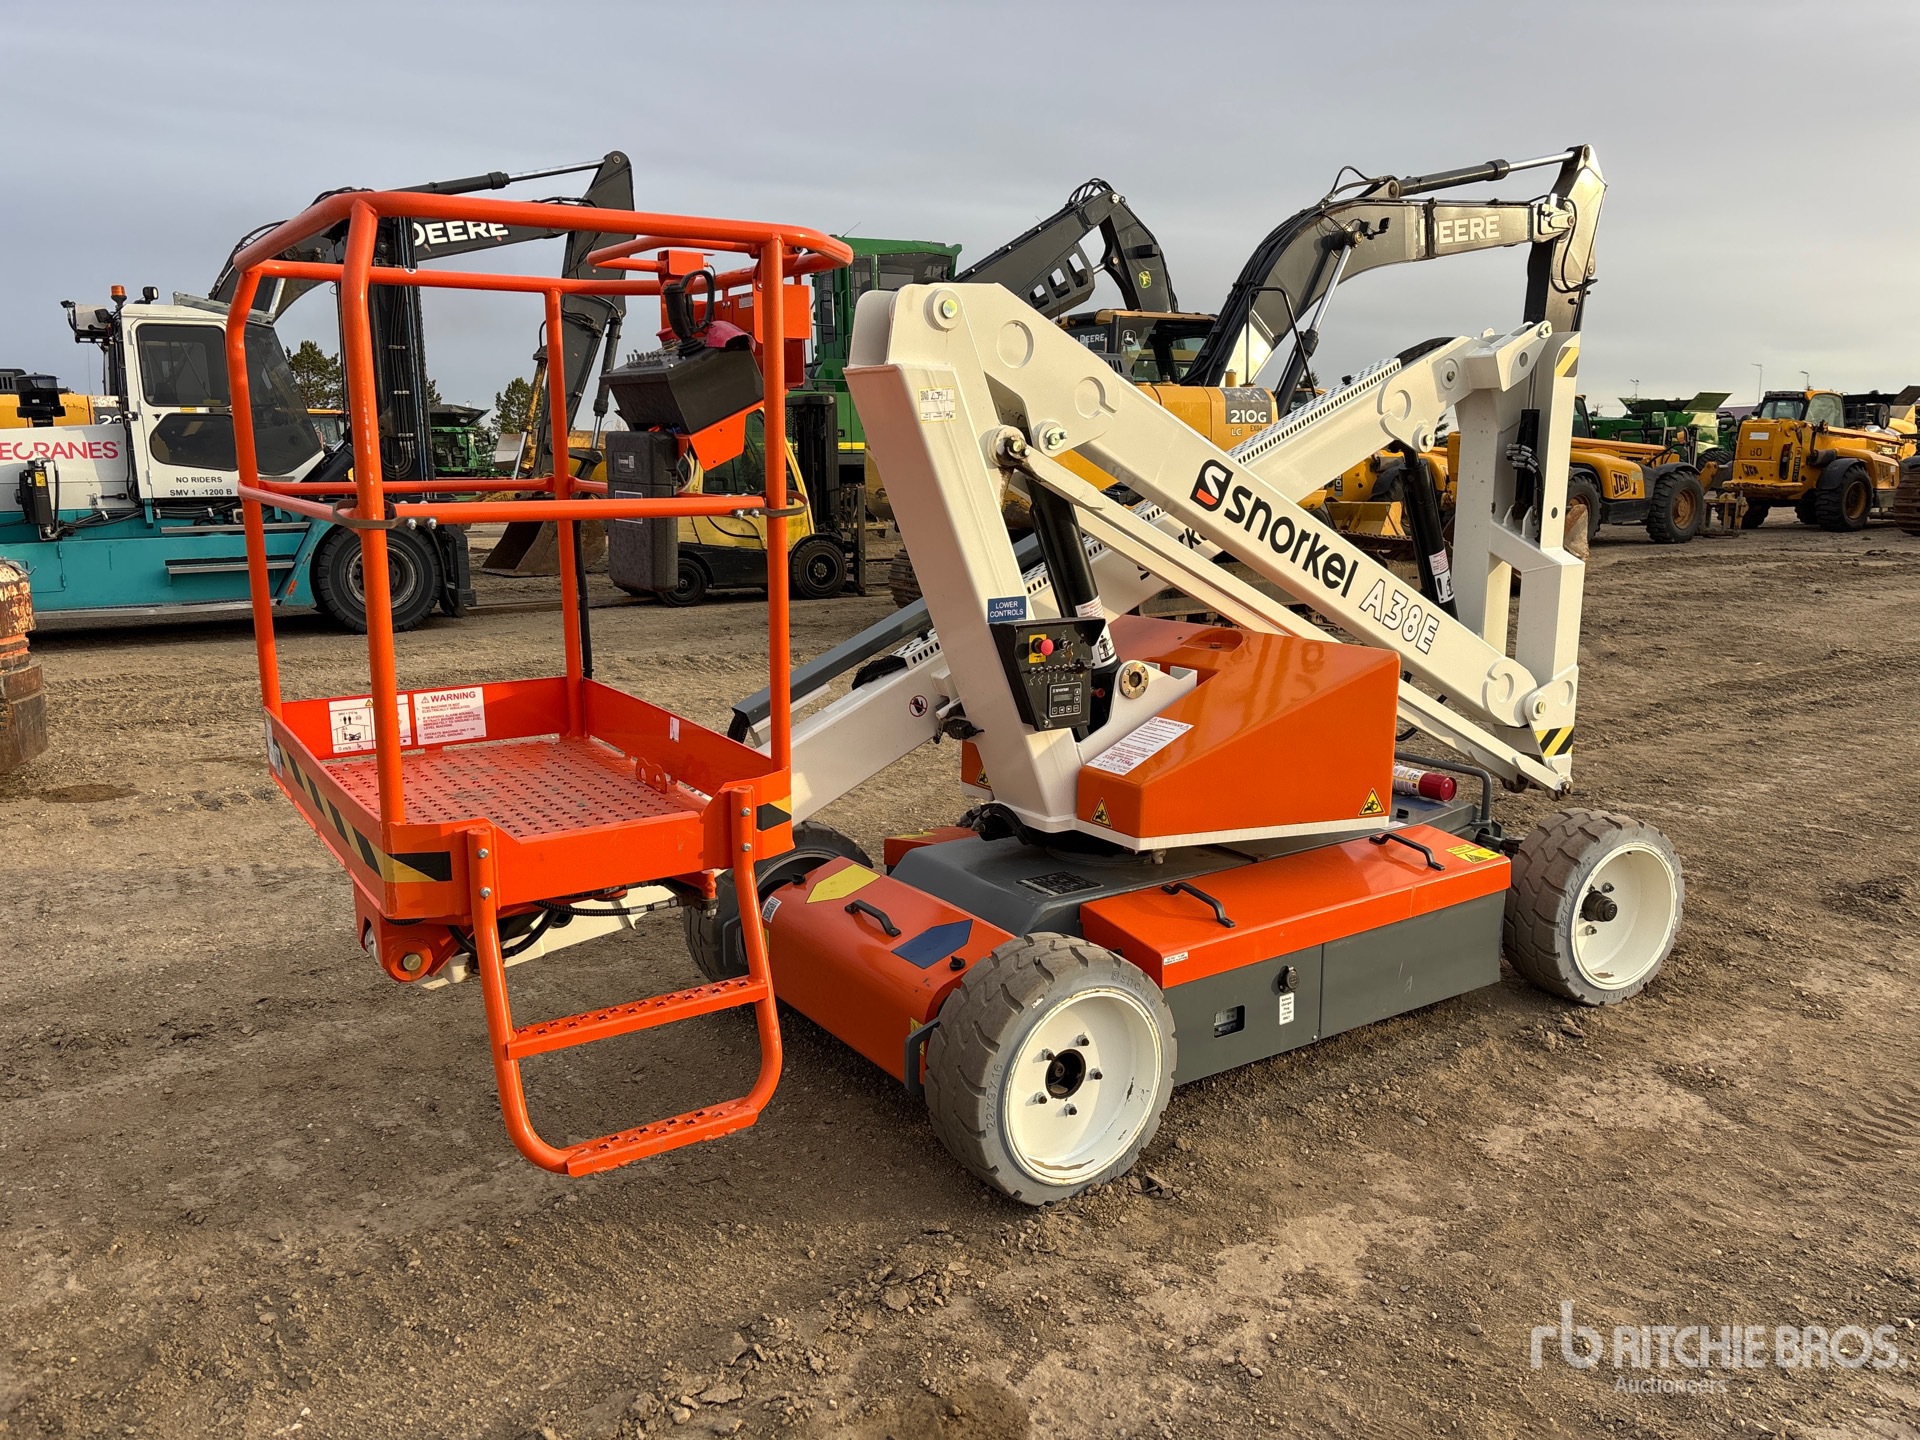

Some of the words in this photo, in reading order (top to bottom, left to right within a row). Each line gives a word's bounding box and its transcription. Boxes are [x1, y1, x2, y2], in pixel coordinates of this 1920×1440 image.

[1080, 333, 1105, 343] DEERE
[1230, 409, 1267, 424] 210G
[1231, 428, 1242, 436] LC
[0, 441, 119, 460] ECRANES
[1613, 473, 1629, 495] JCB
[191, 488, 224, 496] 1-1200
[1223, 485, 1359, 599] snorkel
[1359, 578, 1440, 656] A38E
[995, 601, 1018, 609] LOWER
[989, 609, 1024, 618] CONTROLS
[430, 691, 476, 702] WARNING
[986, 1063, 1003, 1130] 22X9X16
